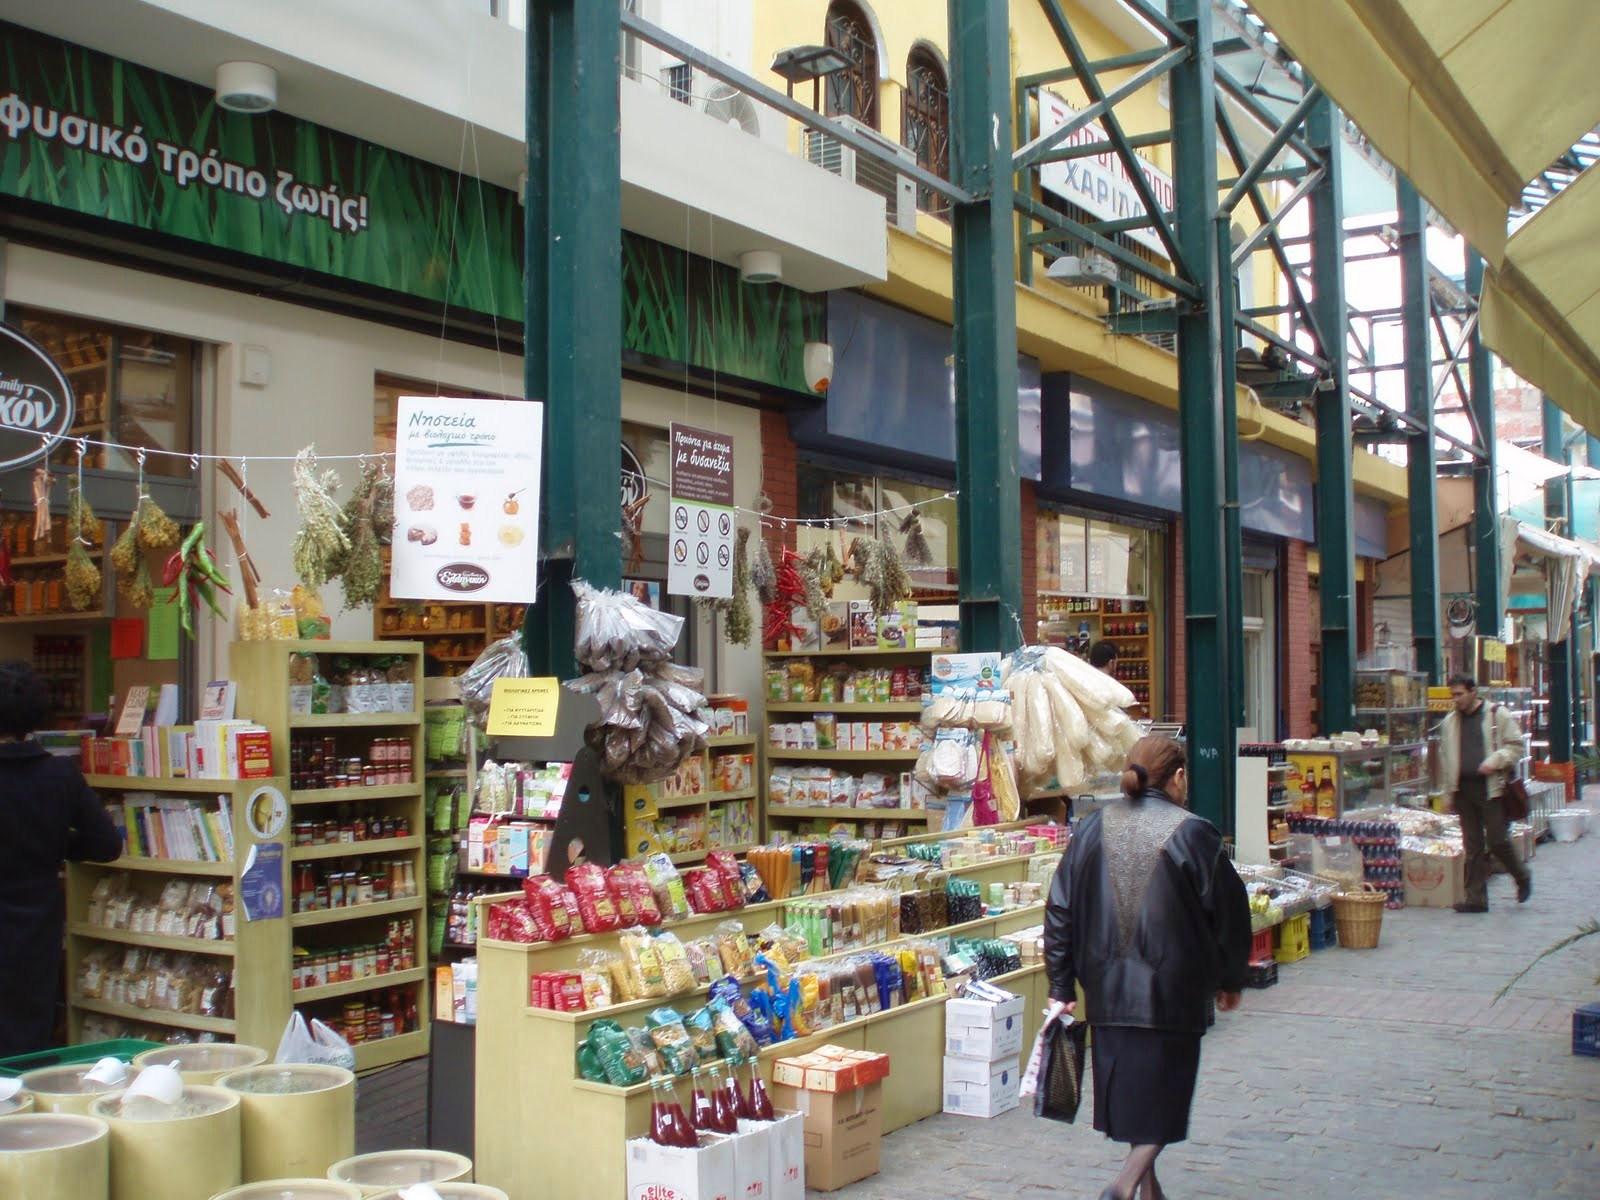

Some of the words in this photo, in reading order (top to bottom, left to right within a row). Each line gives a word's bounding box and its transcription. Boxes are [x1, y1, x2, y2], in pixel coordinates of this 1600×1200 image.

[0, 93, 148, 163] φυσικό
[157, 142, 267, 198] τρόπο
[275, 170, 367, 232] ζωής!
[409, 411, 476, 428] Νηστεία
[676, 450, 687, 467] με
[690, 450, 730, 475] δυσανεξία
